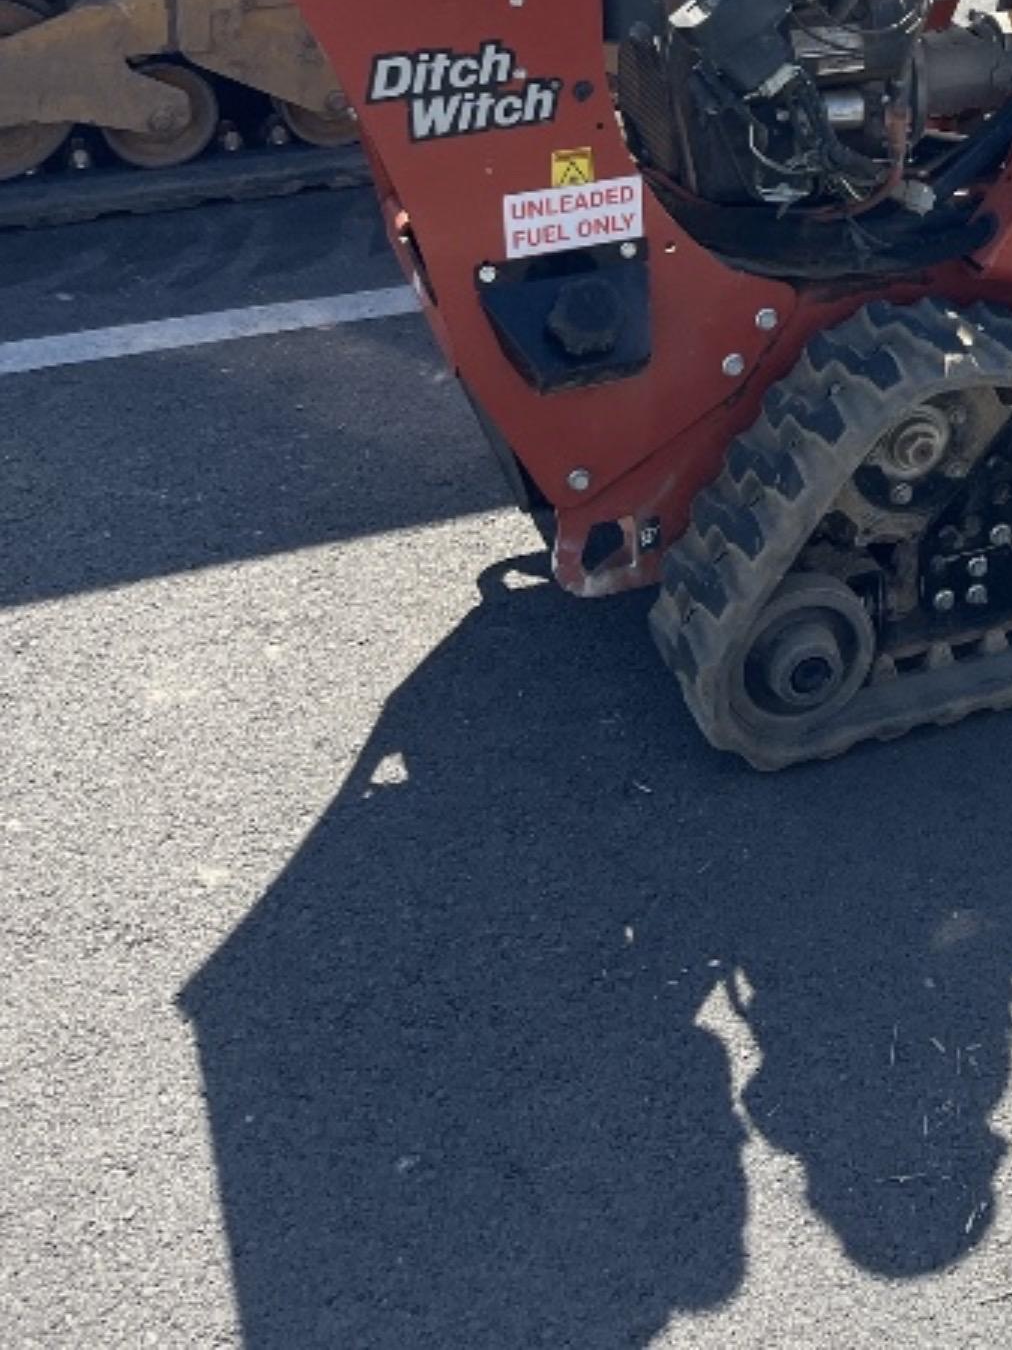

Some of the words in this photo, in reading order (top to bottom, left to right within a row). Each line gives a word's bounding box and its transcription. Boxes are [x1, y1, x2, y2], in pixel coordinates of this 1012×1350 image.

[370, 42, 513, 101] Ditch
[411, 81, 556, 140] Witch
[511, 185, 635, 220] UNLEADED
[512, 223, 571, 250] FUEL
[577, 212, 636, 238] ONLY
